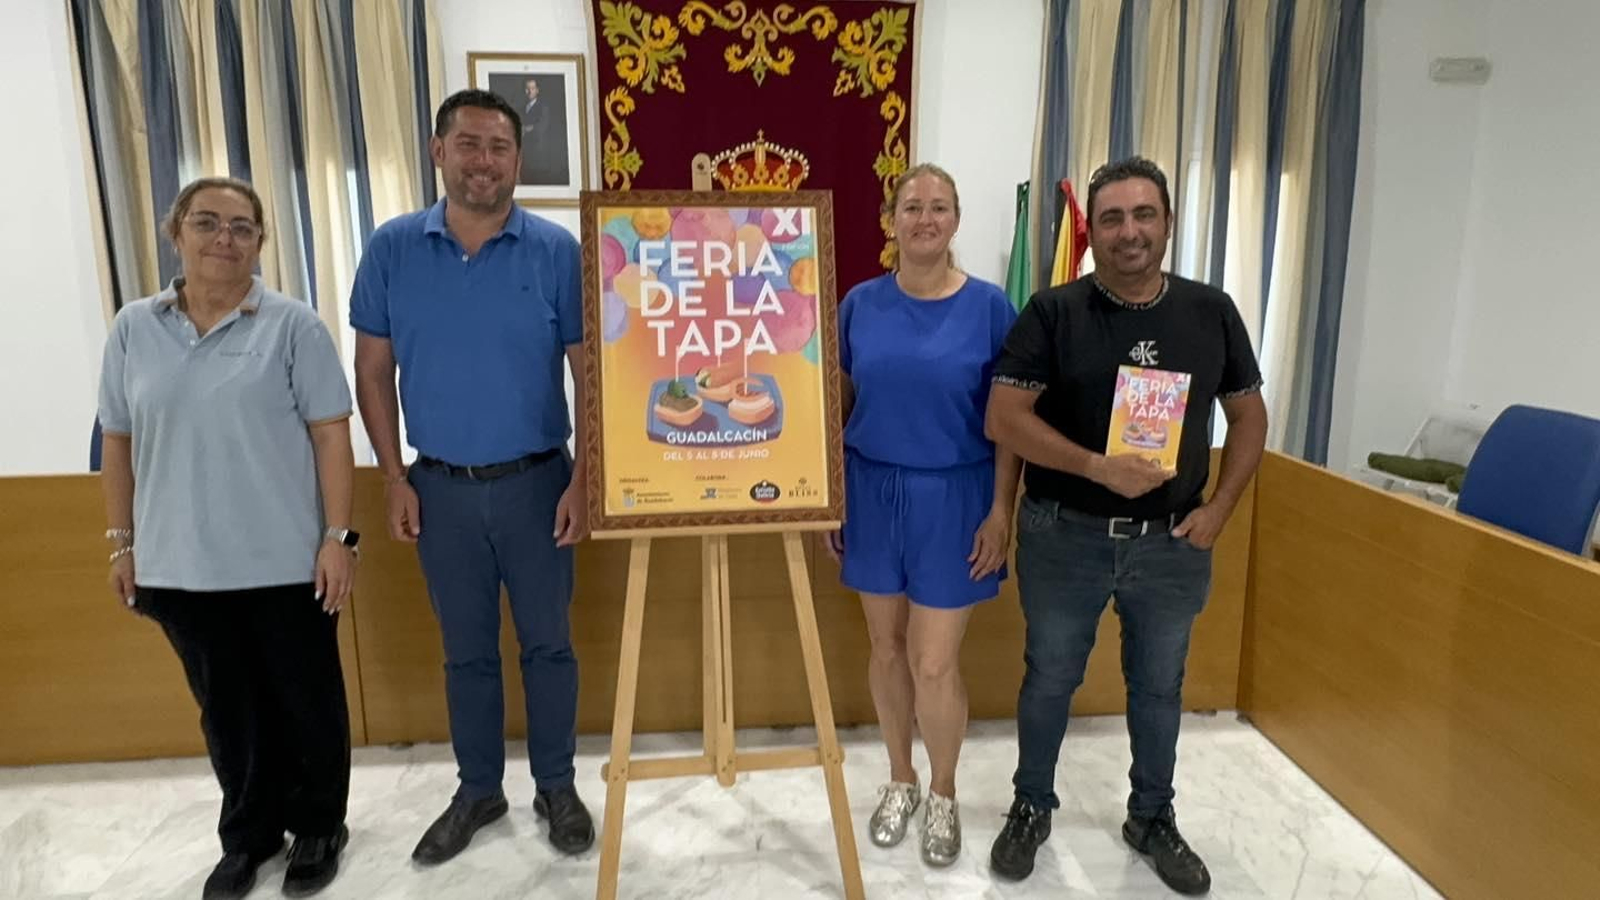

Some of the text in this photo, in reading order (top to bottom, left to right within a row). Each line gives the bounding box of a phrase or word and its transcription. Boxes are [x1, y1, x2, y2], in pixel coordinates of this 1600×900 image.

[772, 207, 811, 237] XI
[639, 240, 783, 277] FERIA
[640, 280, 785, 317] DE LA
[647, 319, 778, 357] TAPA
[1128, 376, 1177, 395] FERIA
[1127, 388, 1175, 409] DE LA
[1129, 403, 1170, 421] TAPA
[666, 427, 767, 444] GUADALCACÍN
[663, 451, 683, 461] DEL
[696, 450, 709, 461] AL
[720, 450, 734, 460] DE
[739, 448, 769, 459] JUNIO
